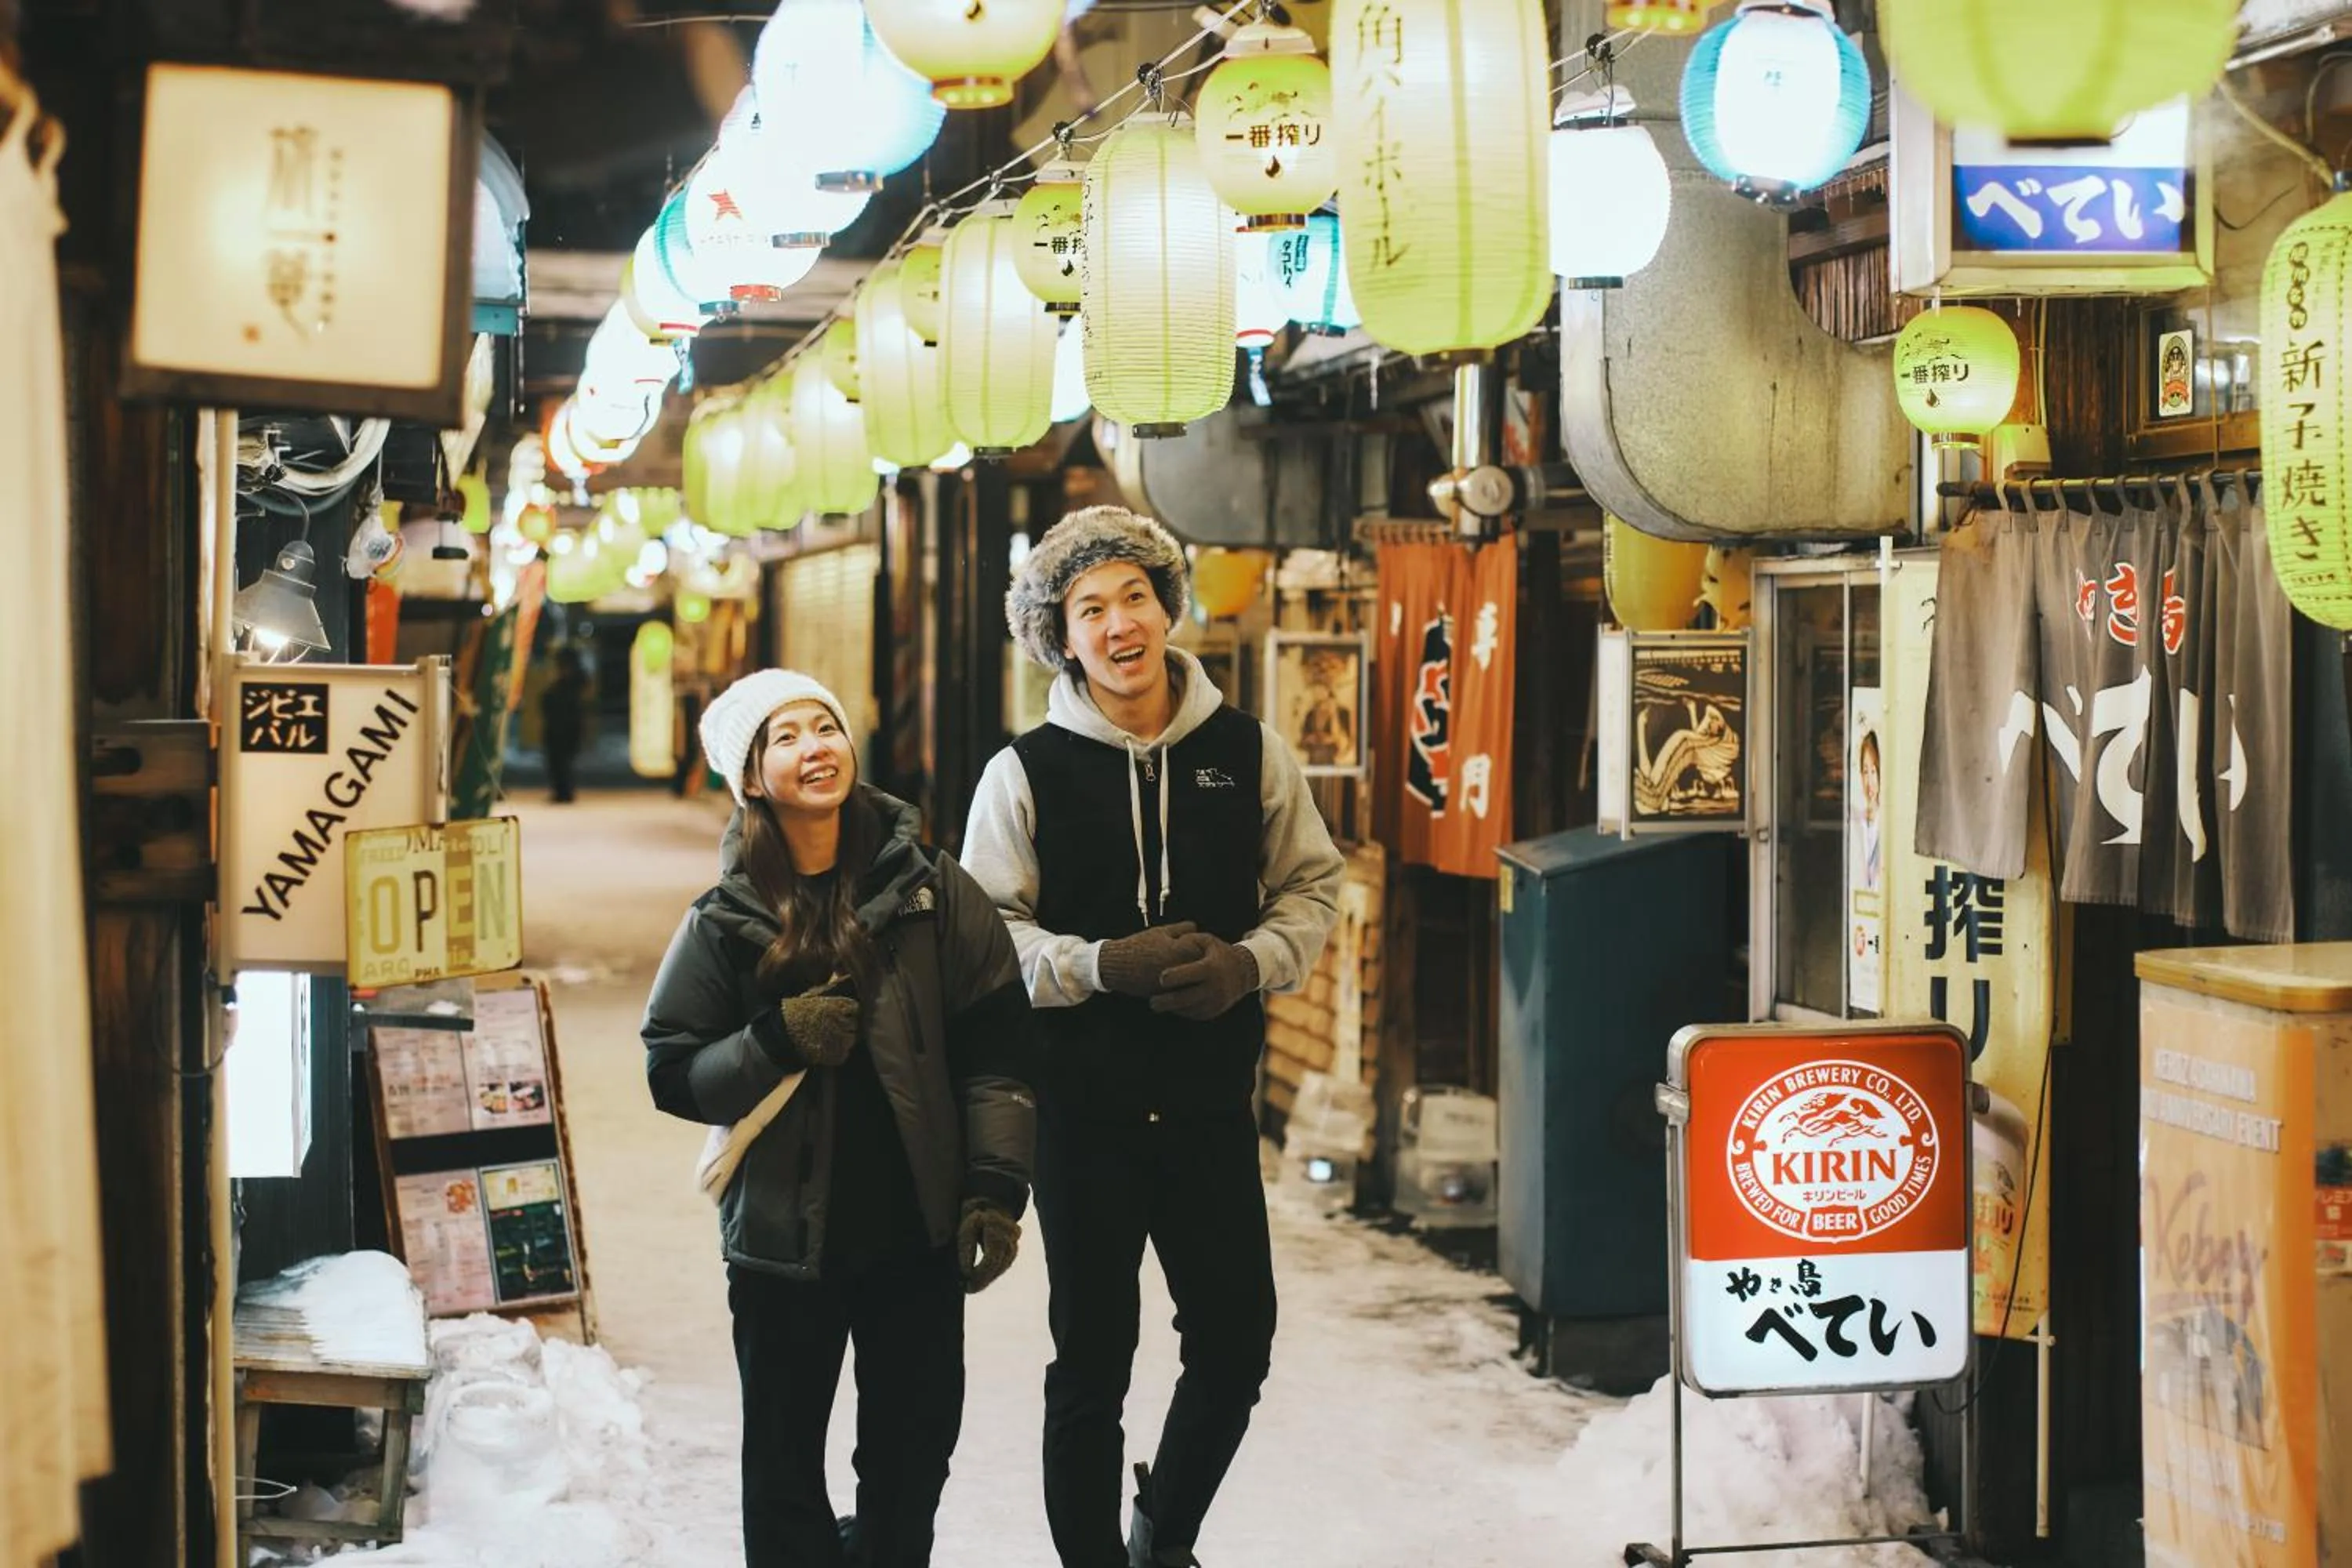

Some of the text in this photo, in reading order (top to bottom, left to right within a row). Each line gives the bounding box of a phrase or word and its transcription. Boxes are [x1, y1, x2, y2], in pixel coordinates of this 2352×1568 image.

[1225, 123, 1321, 147] 一番搾り
[1966, 175, 2184, 243] べてい
[1900, 364, 1969, 383] 一番搾り
[241, 689, 419, 921] YAMAGAMI
[370, 862, 506, 955] OPEN
[1742, 1085, 1782, 1130] KIRIN
[1784, 1067, 1862, 1093] BREWERY
[1893, 1093, 1922, 1124] LTD.
[1735, 1156, 1932, 1229] BREWED FOR GOOD TIMES
[1773, 1149, 1896, 1185] KIRIN
[1802, 1189, 1867, 1203] キリンビール
[1813, 1213, 1858, 1230] BEER
[1726, 1258, 1822, 1301] やき鳥
[1745, 1294, 1937, 1362] べてい
